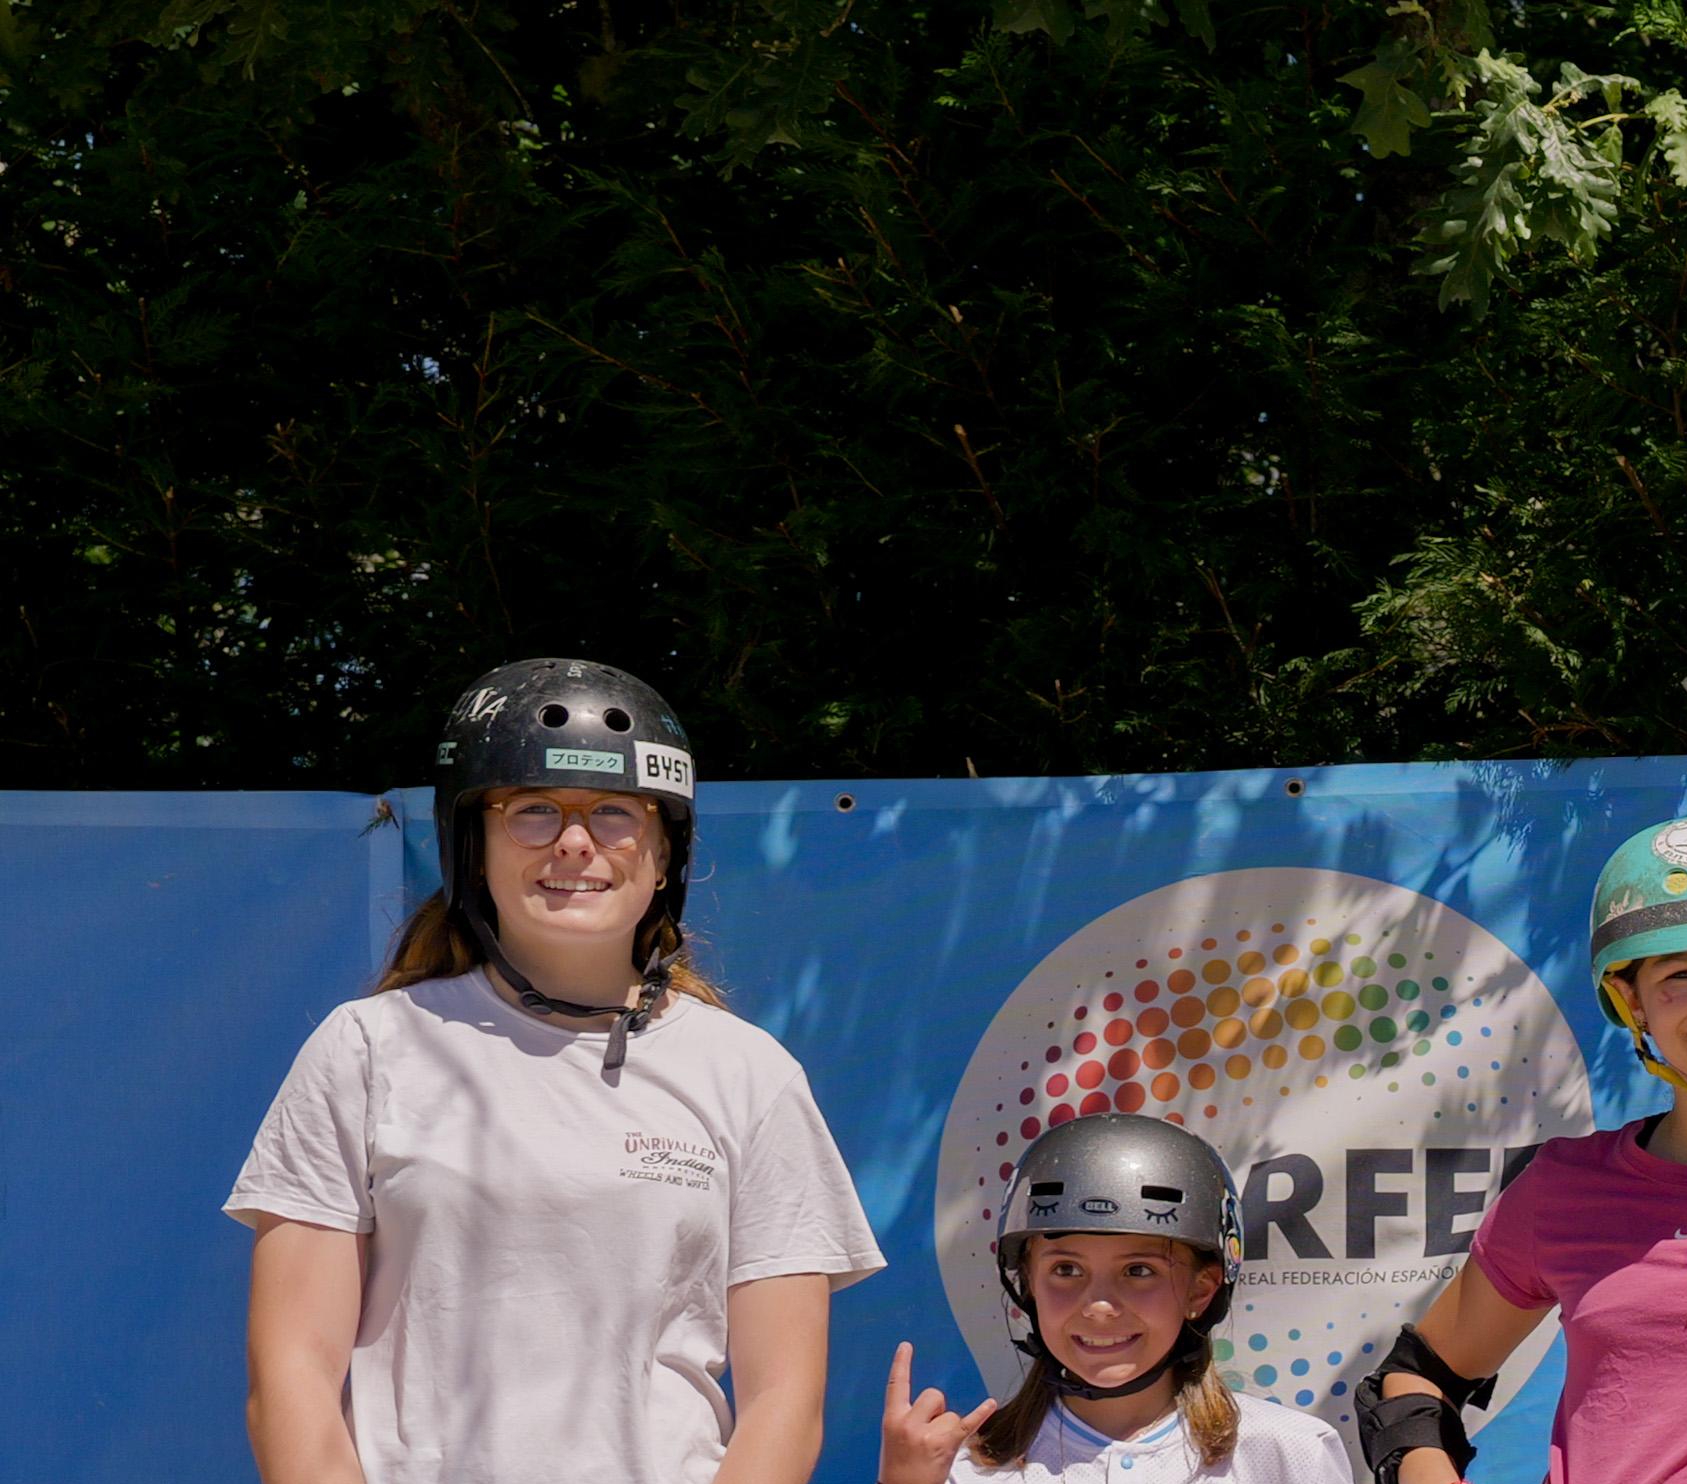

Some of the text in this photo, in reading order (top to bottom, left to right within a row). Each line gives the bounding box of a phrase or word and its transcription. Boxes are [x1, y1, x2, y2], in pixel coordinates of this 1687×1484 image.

[552, 753, 618, 768] プロテック
[641, 1151, 715, 1175] Indian
[1084, 1200, 1115, 1212] BELL
[1238, 1272, 1277, 1286] REAL
[1282, 1267, 1385, 1285] FEDERACIÓN
